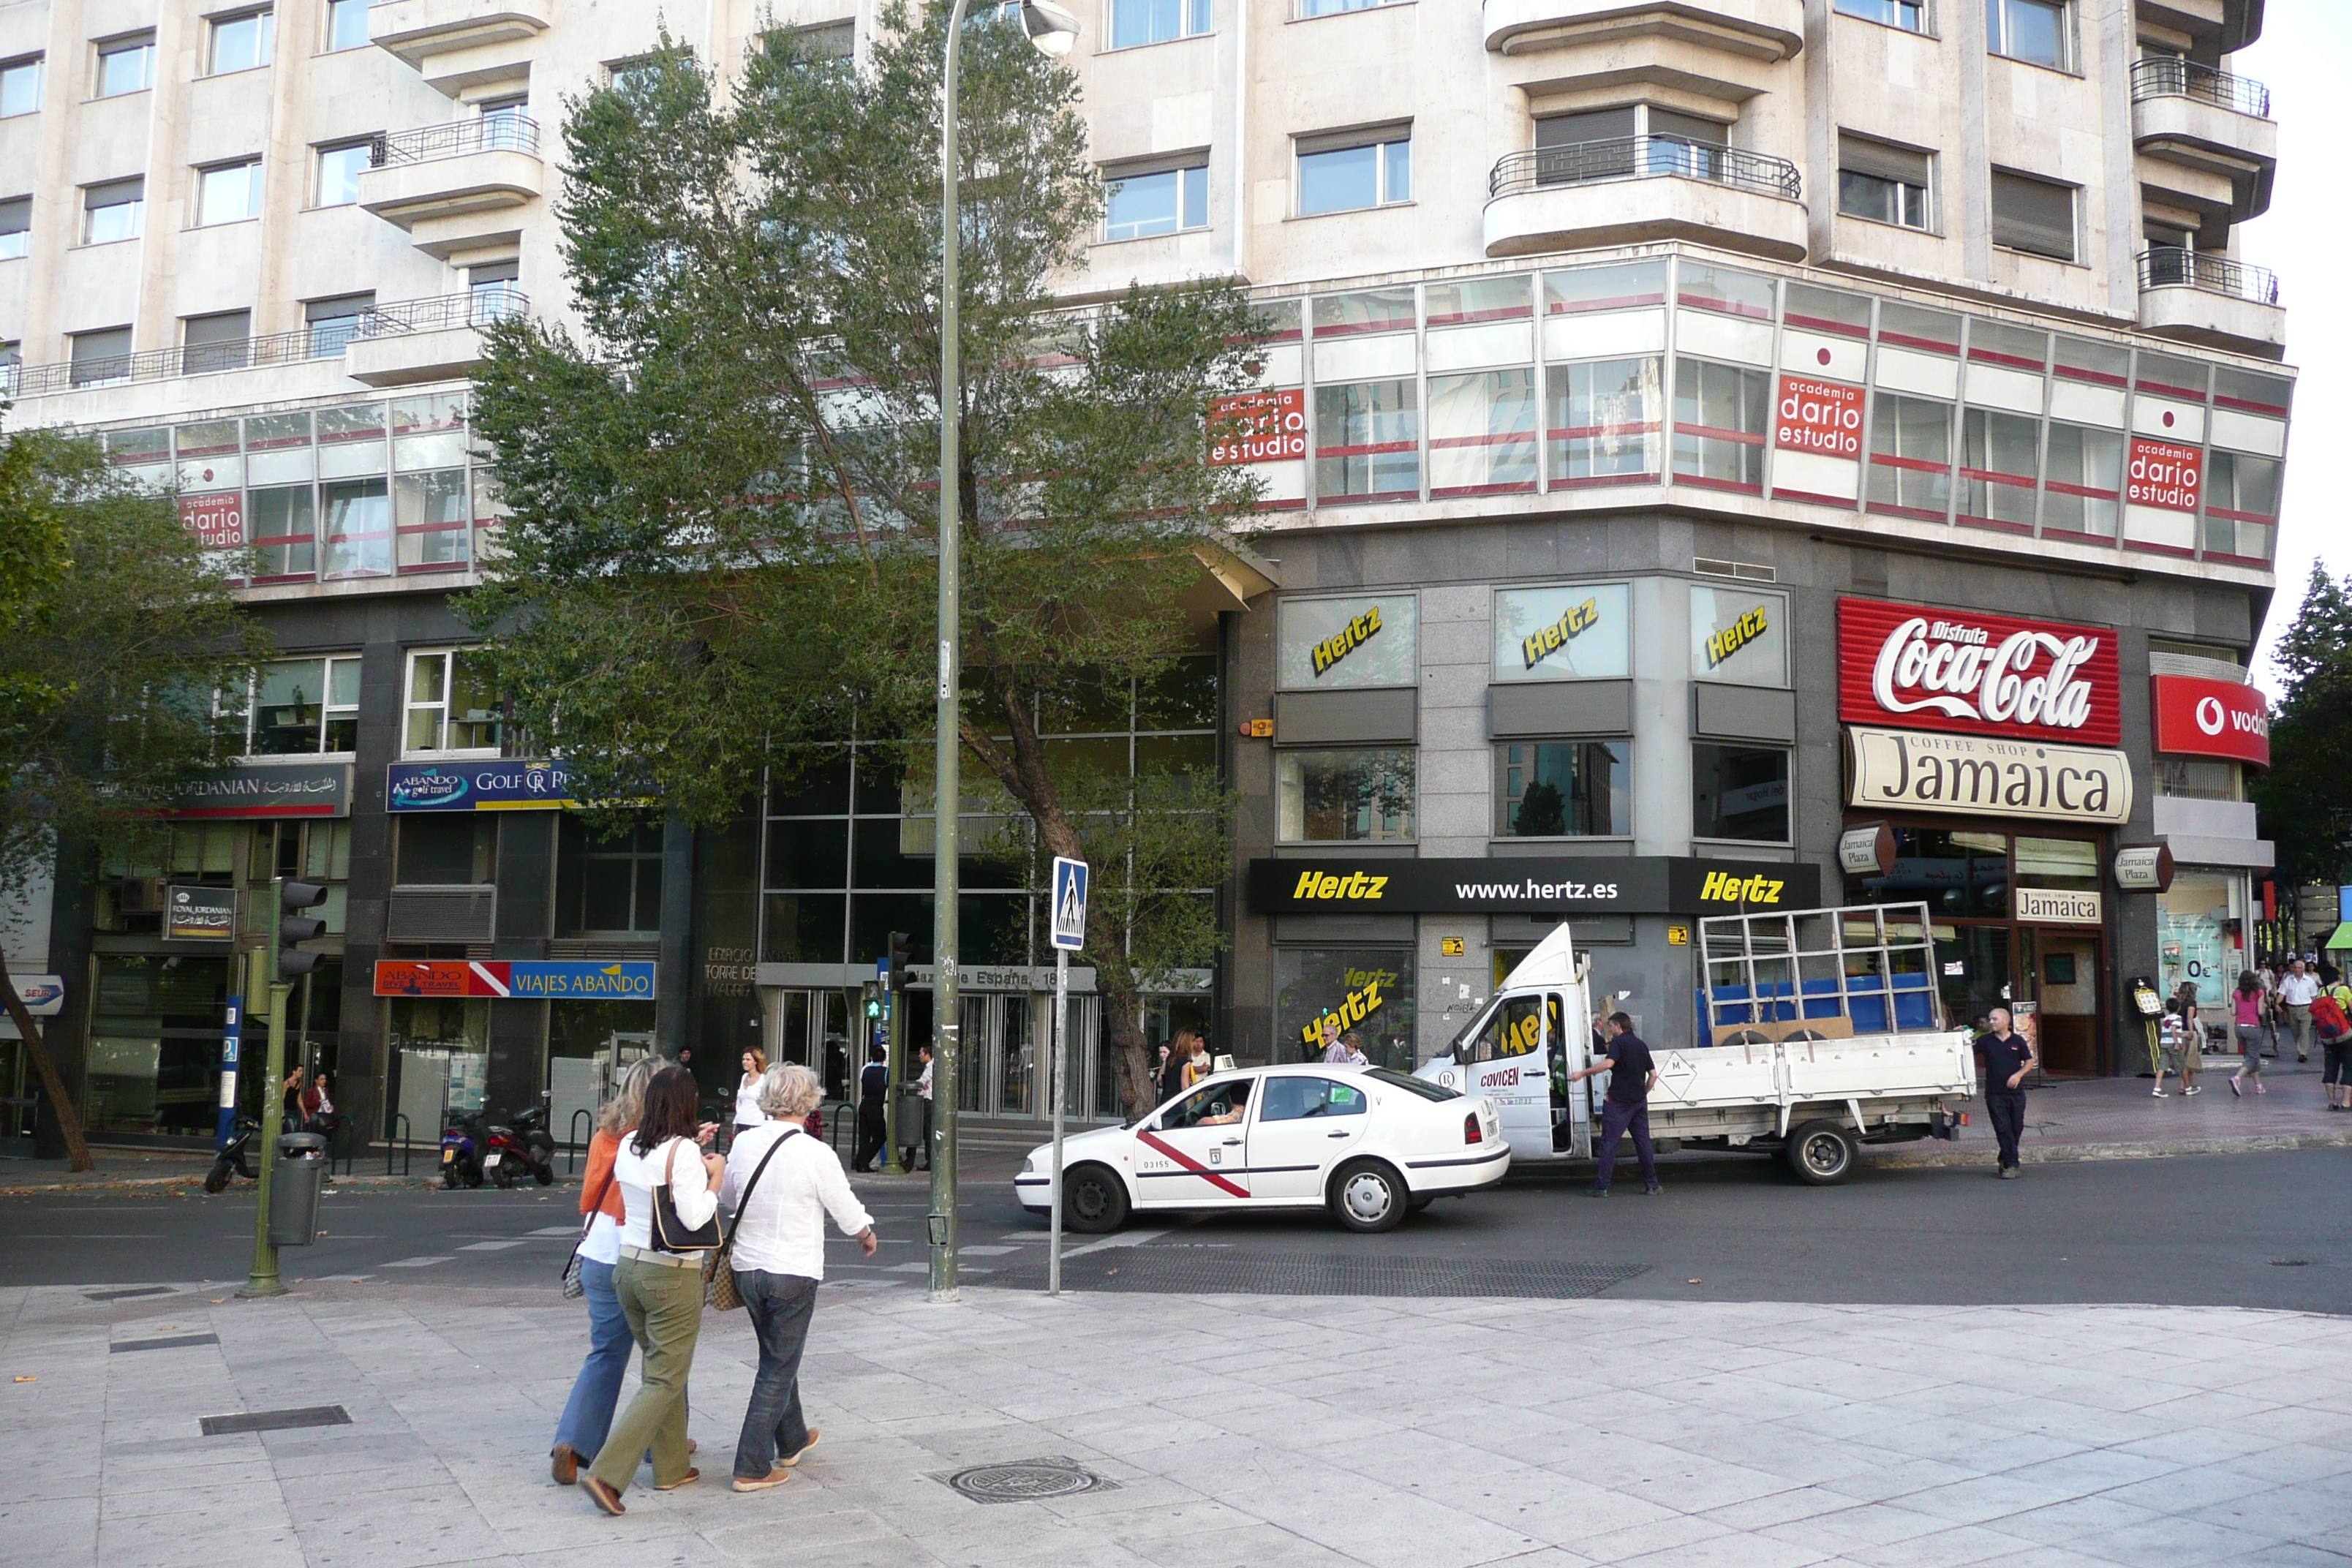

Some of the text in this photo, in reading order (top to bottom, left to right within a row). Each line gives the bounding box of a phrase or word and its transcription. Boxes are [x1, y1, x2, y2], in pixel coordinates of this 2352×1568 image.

[1790, 382, 1855, 401] academia
[1781, 393, 1860, 429] dario
[1214, 408, 1304, 437] ario
[1212, 436, 1305, 461] estudio
[1779, 426, 1858, 452] estudio
[2138, 445, 2193, 460] academia
[2130, 456, 2196, 487] dario
[186, 497, 234, 508] academia
[2129, 484, 2195, 507] estudio
[183, 508, 240, 530] dario
[200, 529, 241, 546] tudio
[1312, 606, 1382, 674] Hertz
[1523, 596, 1599, 666] Hertz
[1706, 605, 1768, 666] Hertz
[1930, 621, 1989, 645] Disfruta
[1873, 617, 2099, 729] Coca-Cola
[2231, 708, 2268, 739] voda
[1910, 736, 2028, 757] COFFEE SHOP
[402, 774, 458, 785] ABANDO
[476, 772, 524, 791] GOLF
[1882, 735, 2109, 813] Jamaica
[412, 784, 453, 797] golf travel
[1842, 838, 1874, 851] Jamaica
[1848, 852, 1869, 863] Plaza
[2118, 856, 2154, 867] Jamaica
[2125, 869, 2149, 879] Plaza
[1293, 871, 1389, 899] Hertz
[1455, 879, 1618, 899] www.hertz.es
[1700, 871, 1784, 903] Hertz
[173, 905, 233, 915] ROYAL JORDANIAN
[2021, 893, 2096, 917] Jamaica
[384, 970, 461, 981] ABANDO
[705, 965, 756, 981] TORRE DE
[25, 989, 50, 998] SEUR
[516, 974, 649, 995] VIAJES ABANDO
[1673, 1061, 1681, 1070] M
[1480, 1066, 1519, 1088] COVICEN
[1144, 1161, 1169, 1169] 03155
